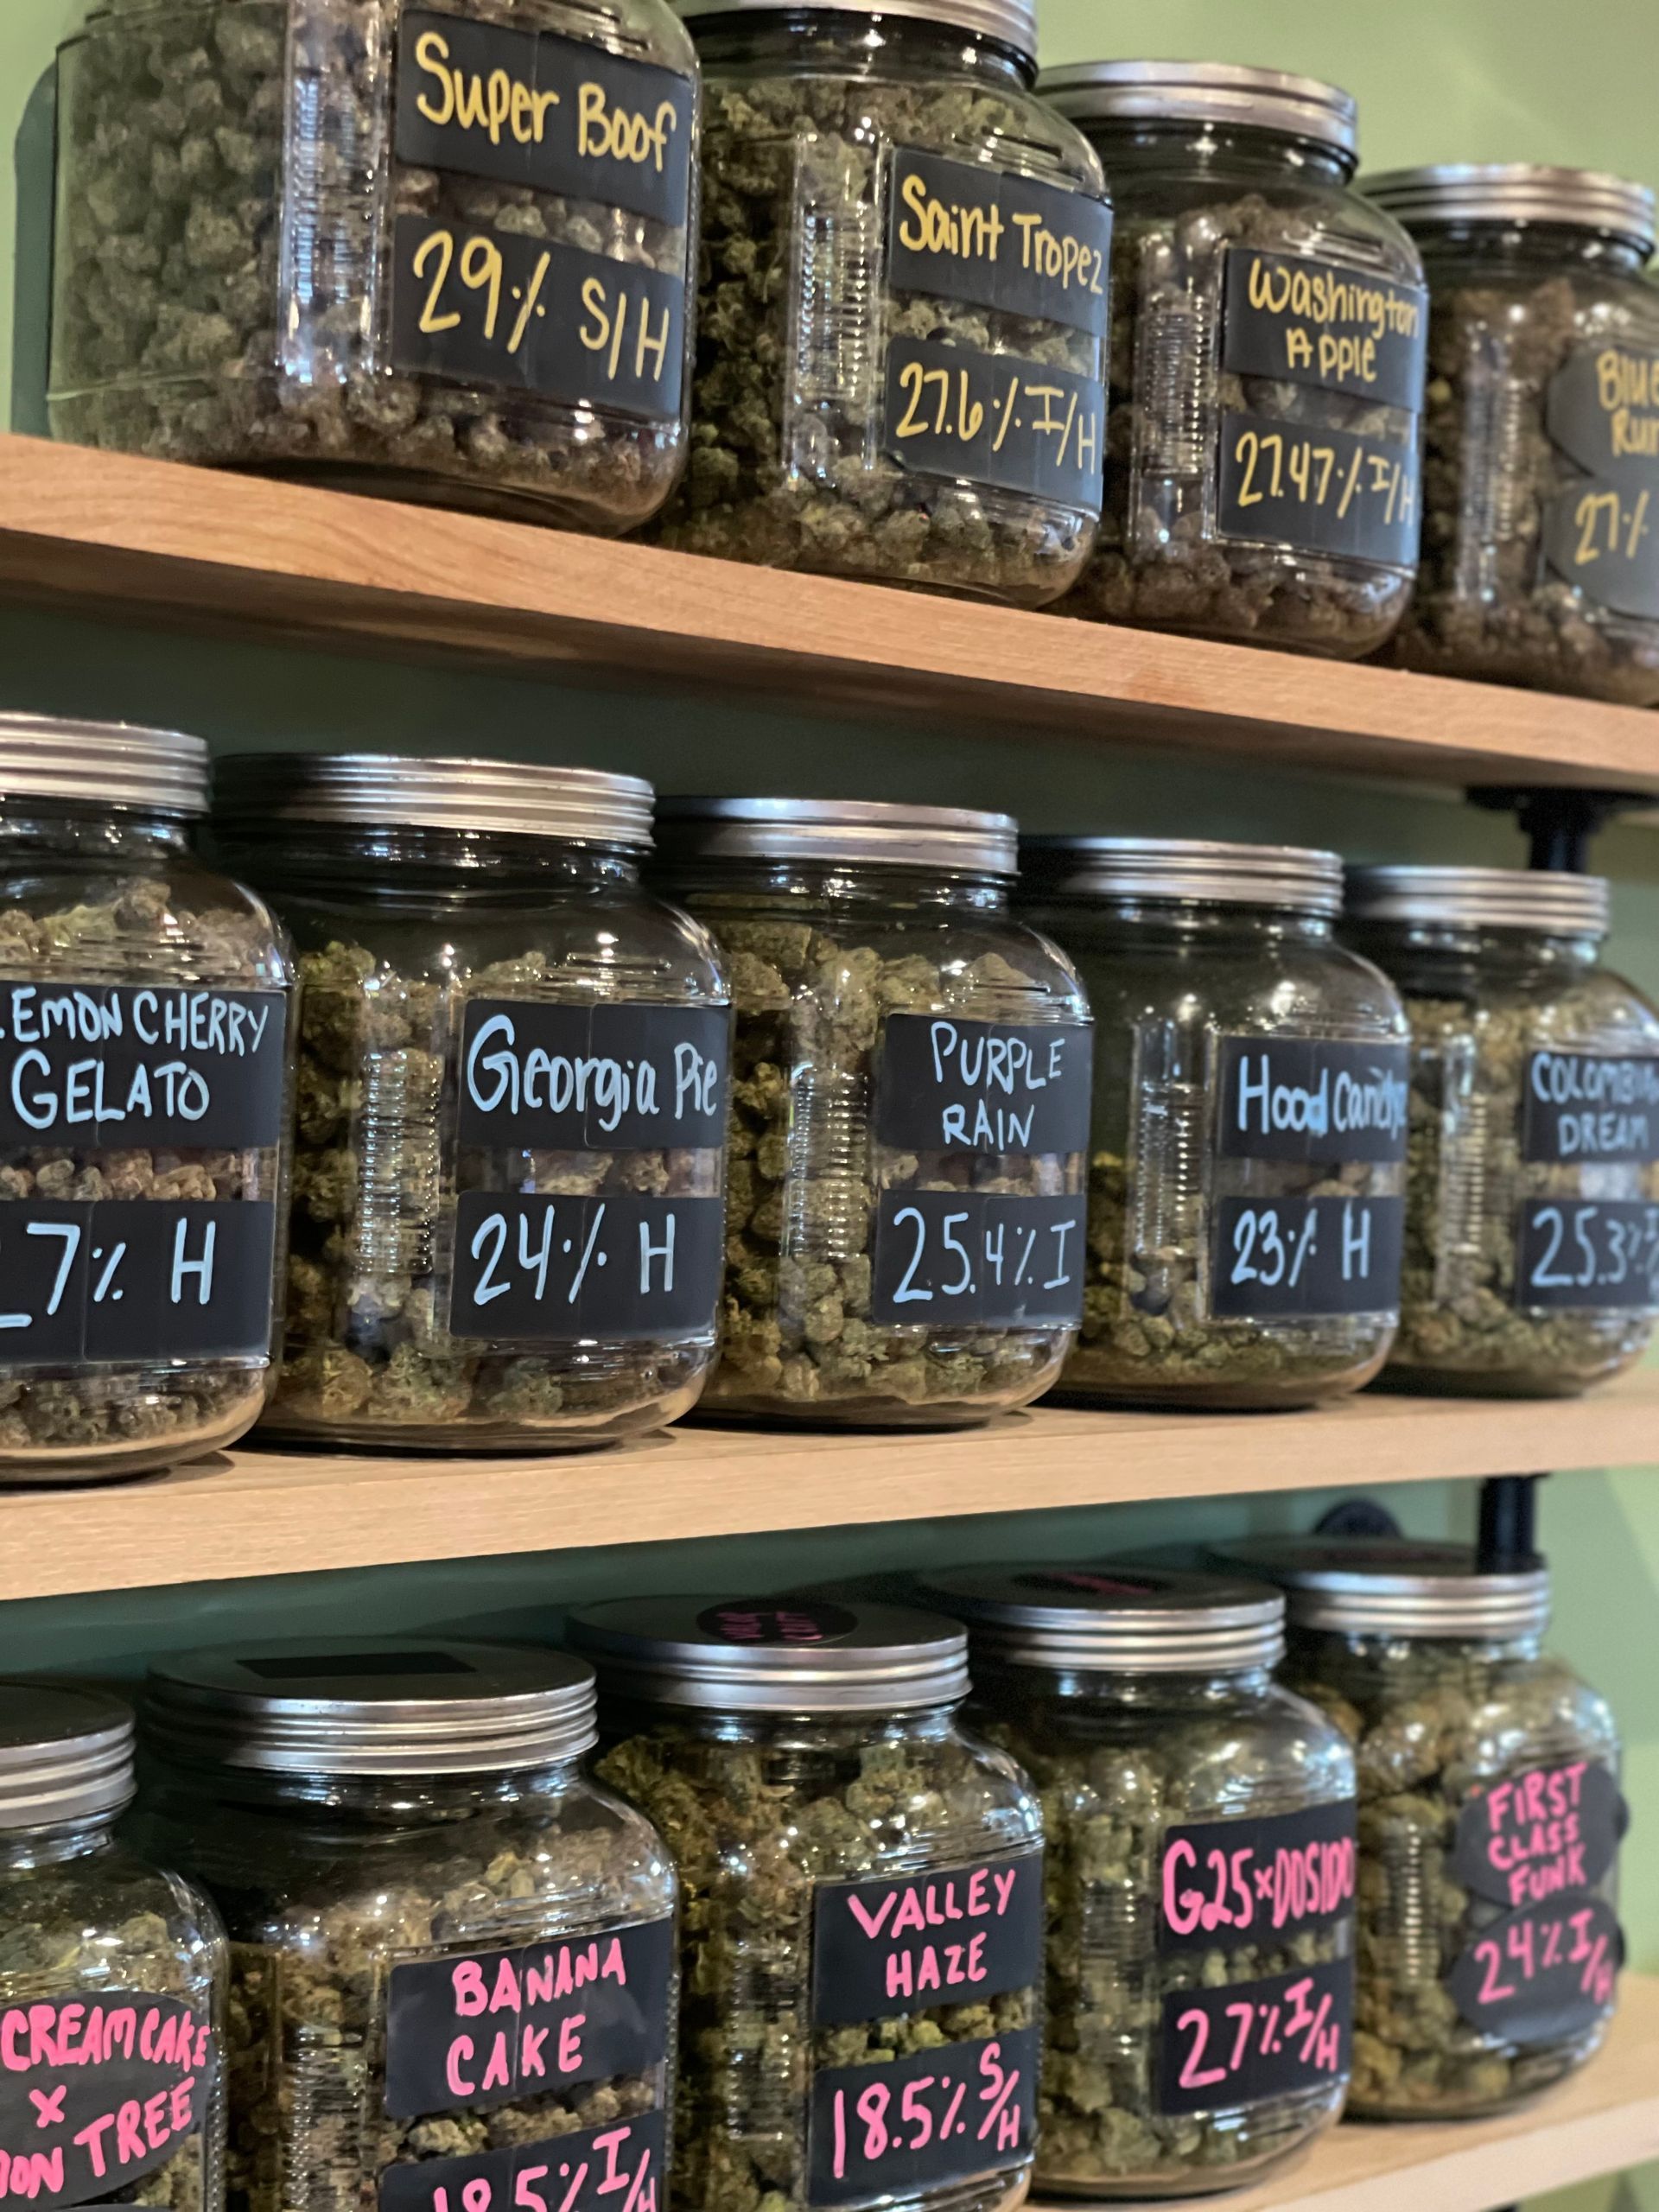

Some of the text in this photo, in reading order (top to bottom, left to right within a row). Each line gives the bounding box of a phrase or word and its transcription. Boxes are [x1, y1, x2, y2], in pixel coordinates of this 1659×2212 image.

[416, 32, 677, 172] Super Boof
[899, 175, 1004, 261] Saint
[413, 231, 670, 382] 29% S/H
[1249, 258, 1419, 340] Washington
[1285, 328, 1377, 383] Apple
[895, 362, 1022, 452] 27.6%
[1575, 490, 1649, 565] 27%
[0, 986, 269, 1057] EMON CHERRY
[931, 1021, 1065, 1094] PURPLE
[11, 1048, 210, 1129] GELATO
[467, 1014, 717, 1131] Georgia Pie
[1238, 1054, 1328, 1135] Hood
[943, 1099, 1034, 1150] RAIN
[1558, 1112, 1649, 1156] DREAM
[171, 1217, 216, 1305] H
[471, 1204, 675, 1306] 24% H
[893, 1207, 1077, 1303] 25.4% I
[1230, 1203, 1371, 1287] 23% H
[1487, 1762, 1588, 1834] FIRST
[1488, 1813, 1580, 1871] CLASS
[1508, 1843, 1586, 1906] FUNK
[847, 1868, 1016, 1939] VALLEY
[452, 1938, 626, 2017] BANANA
[886, 1931, 988, 1999] HAZE
[1474, 1920, 1562, 2005] 24%
[446, 2013, 587, 2096] CAKE
[1176, 2002, 1282, 2088] 27%
[73, 2075, 195, 2177] TREE
[833, 2042, 1021, 2179] 18.5% S/H
